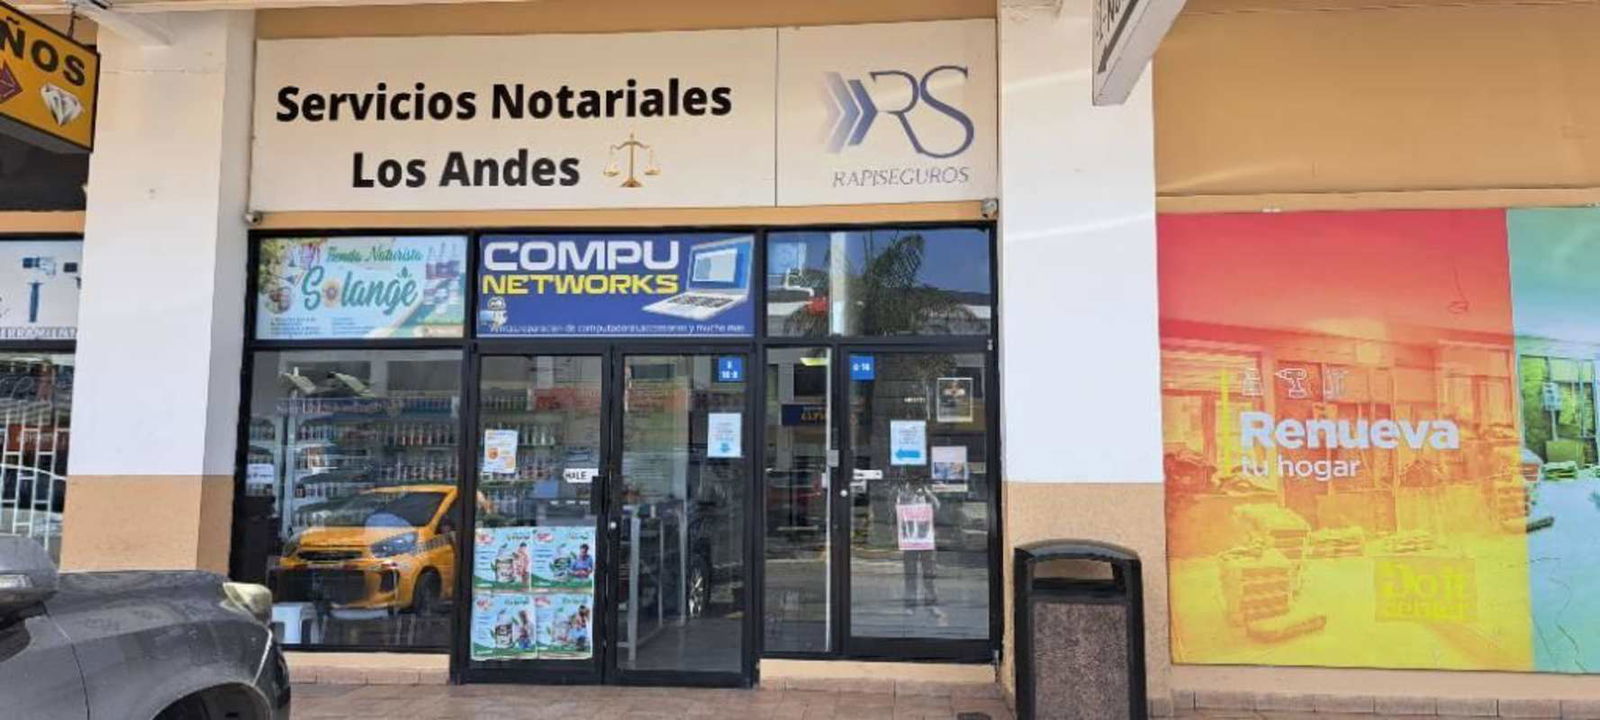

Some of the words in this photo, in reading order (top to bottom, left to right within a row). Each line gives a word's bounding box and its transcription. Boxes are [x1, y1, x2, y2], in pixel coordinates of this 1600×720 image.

[275, 82, 477, 123] Servicios
[492, 78, 733, 120] Notariales
[352, 151, 427, 189] Los
[439, 148, 581, 188] Andes
[832, 166, 971, 188] RAPISEGUROS
[483, 240, 680, 271] COMPU
[482, 274, 680, 295] NETWORKS
[1240, 411, 1461, 450] Renueva
[1241, 456, 1269, 477] tu
[1277, 455, 1360, 481] hogar
